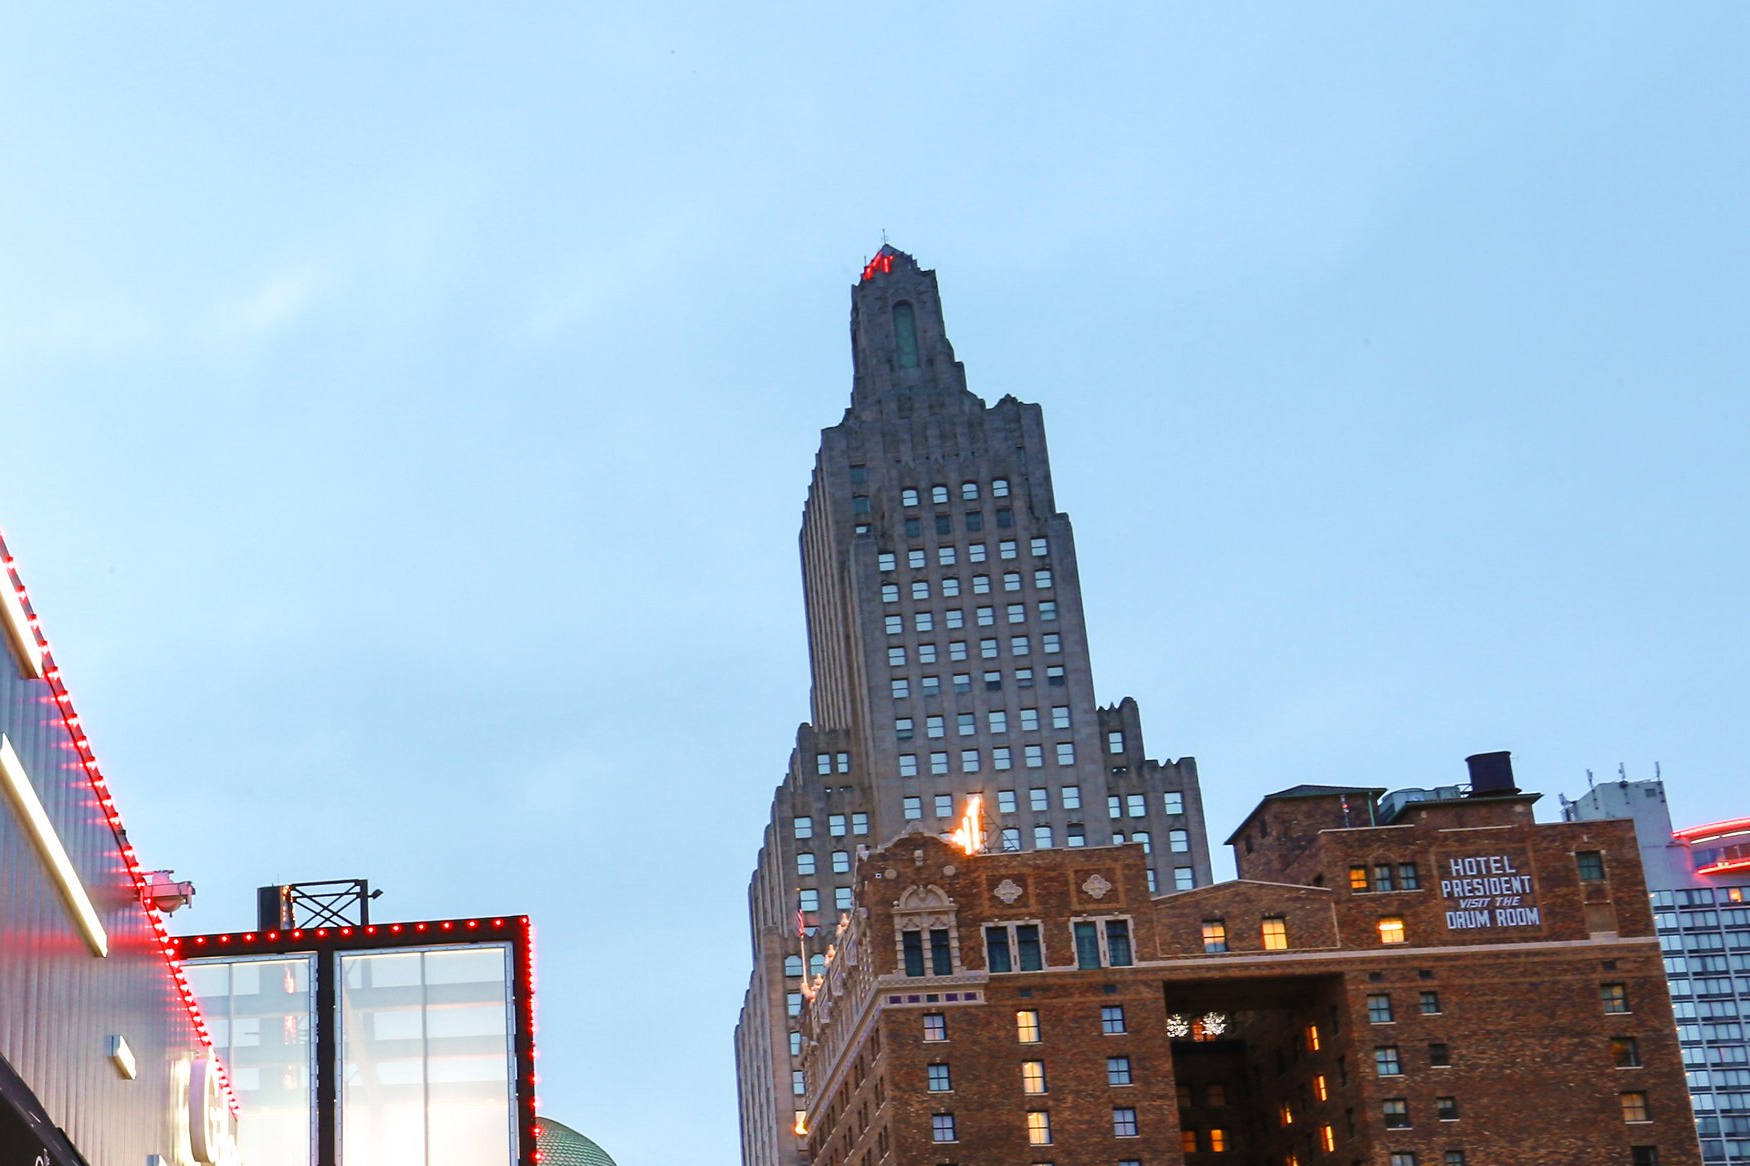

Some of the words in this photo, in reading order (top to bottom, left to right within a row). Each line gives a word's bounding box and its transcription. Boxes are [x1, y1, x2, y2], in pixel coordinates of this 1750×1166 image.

[1450, 856, 1517, 876] HOTEL
[1441, 876, 1531, 898] PRESIDENT
[1460, 898, 1491, 909] VISIT
[1495, 896, 1521, 907] THE
[1445, 910, 1491, 930] DRUM
[1495, 907, 1541, 927] ROOM
